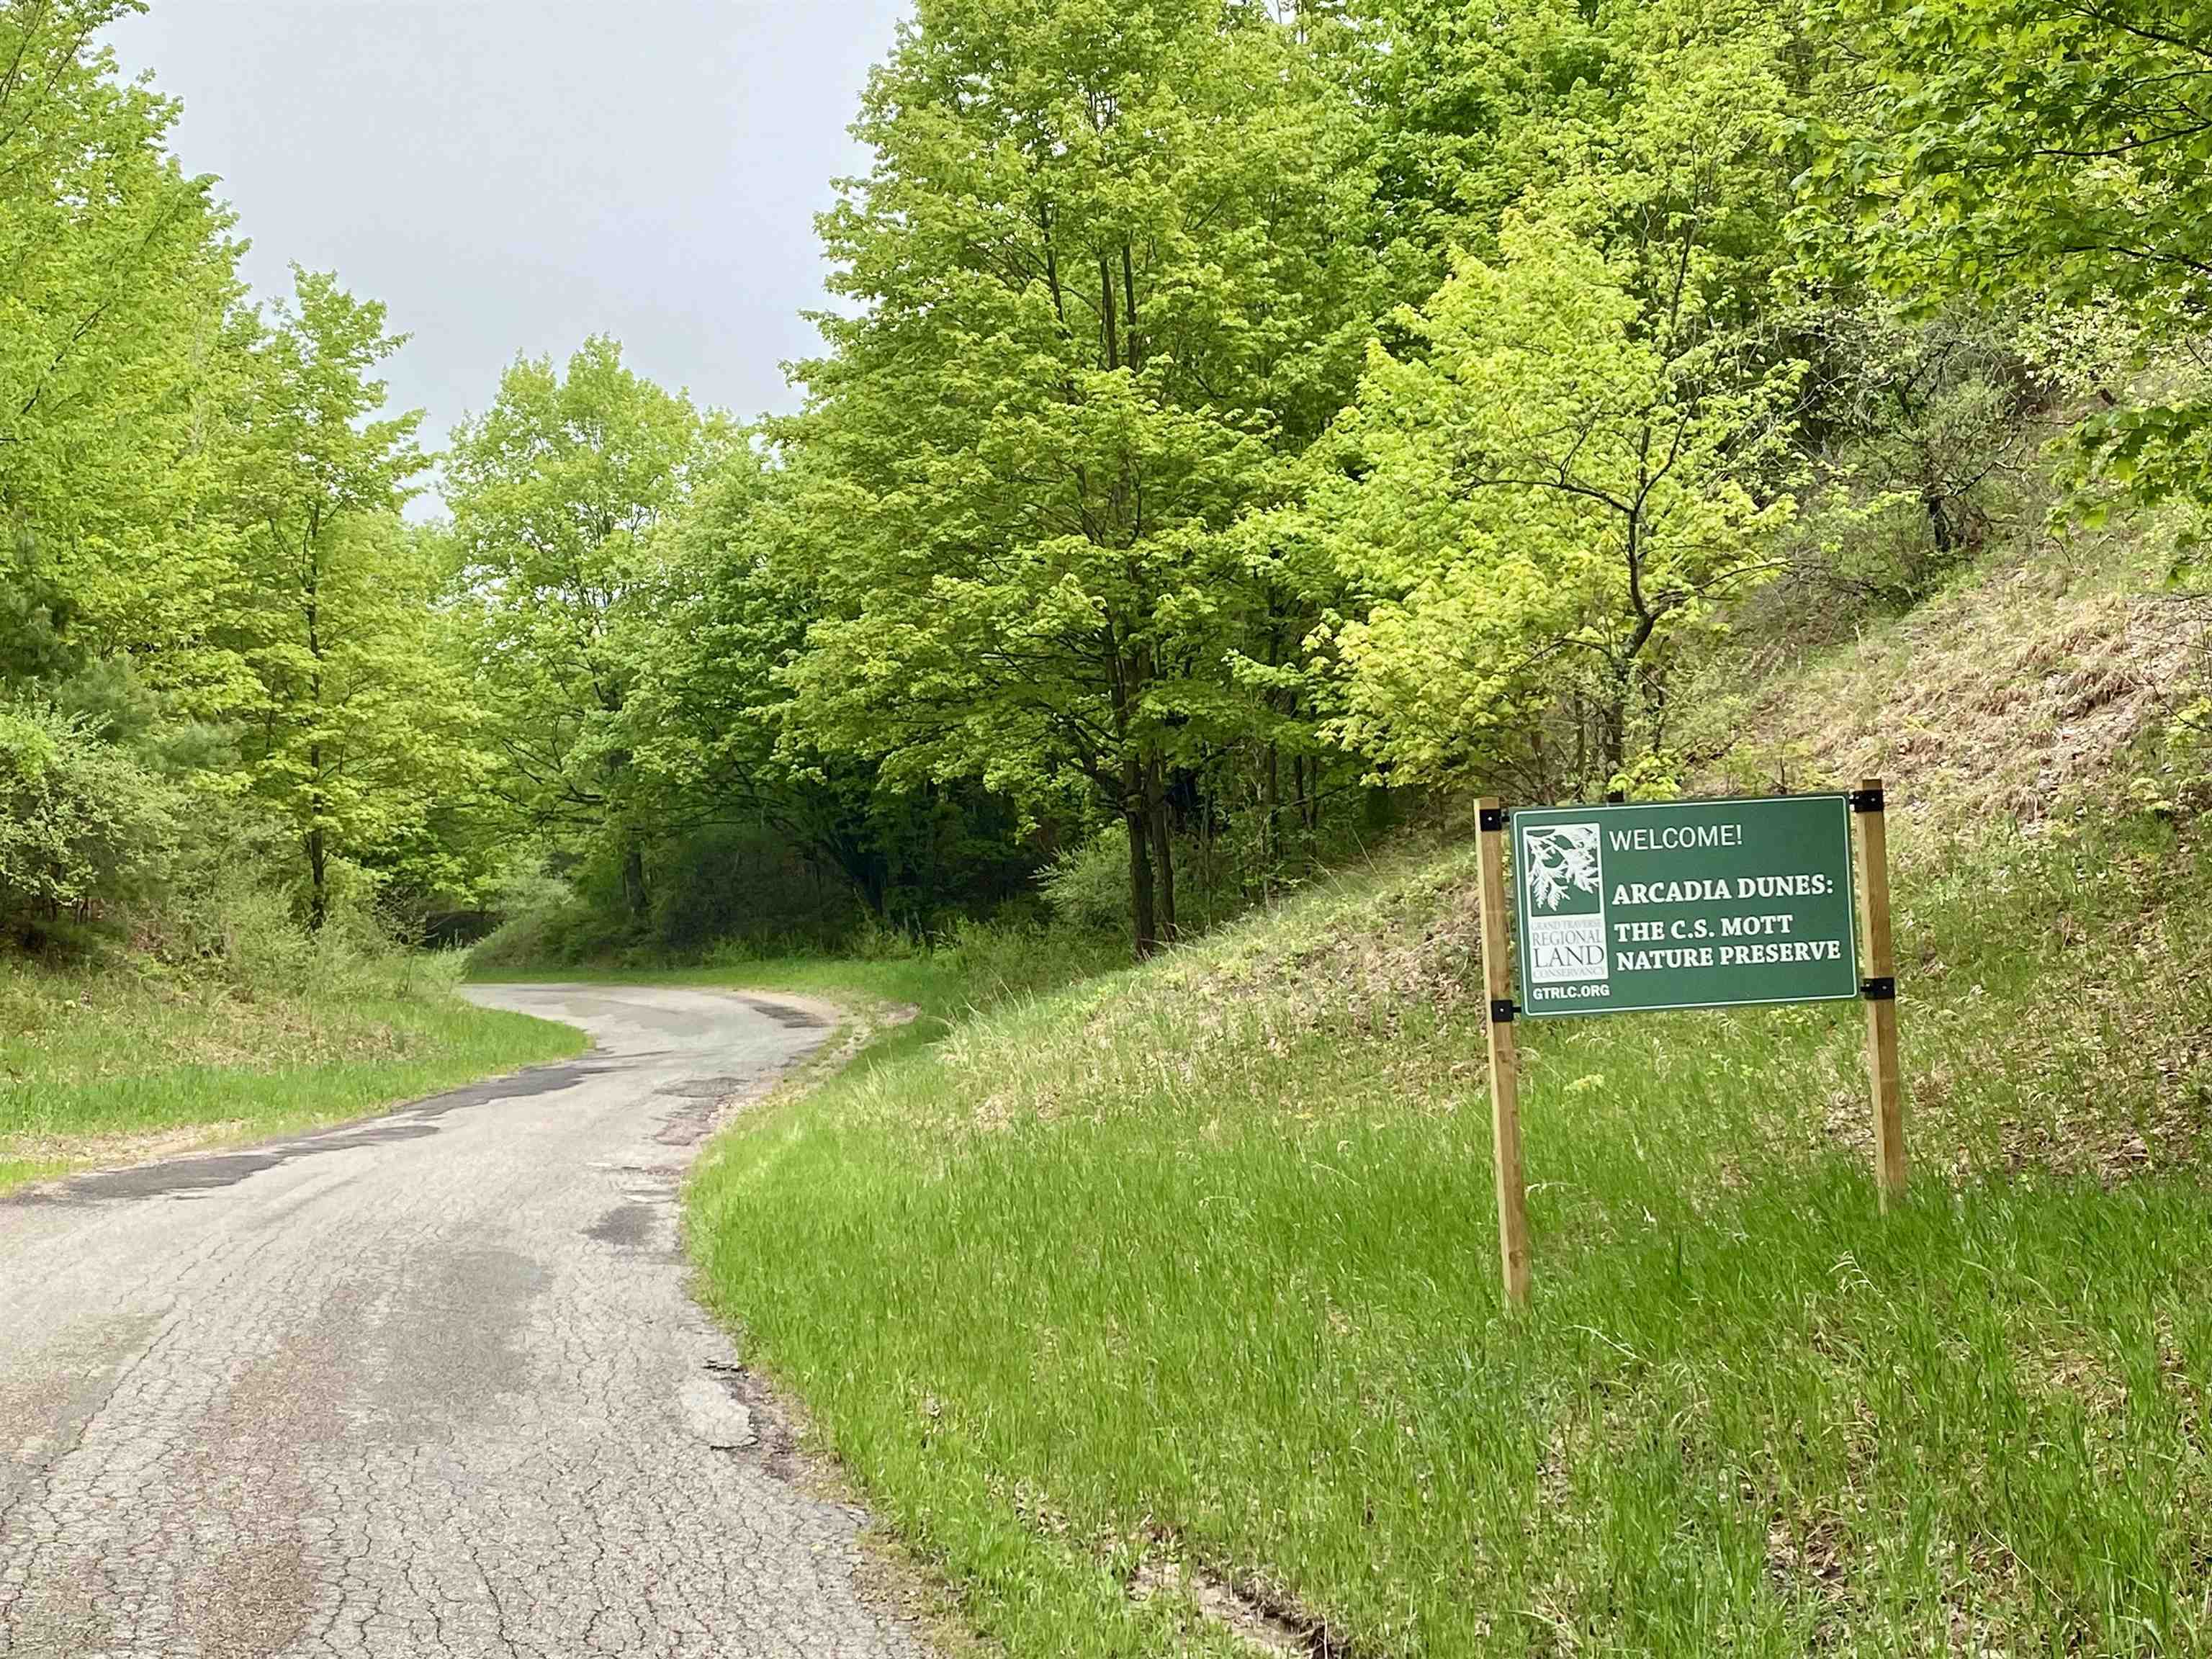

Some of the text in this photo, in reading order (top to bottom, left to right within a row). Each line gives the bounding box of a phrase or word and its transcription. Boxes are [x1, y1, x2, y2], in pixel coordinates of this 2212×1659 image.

[1609, 824, 1743, 852] WELCOME!
[1611, 874, 1833, 905] ARCADIA DUNES:
[1532, 930, 1602, 946] REGIONAL
[1614, 914, 1793, 943] THE C.S. MOTT
[1533, 945, 1604, 968] LAND
[1617, 940, 1841, 971] NATURE PRESERVE
[1533, 966, 1605, 979] CONSERVANCY
[1532, 984, 1610, 1000] GTRLC.ORG
